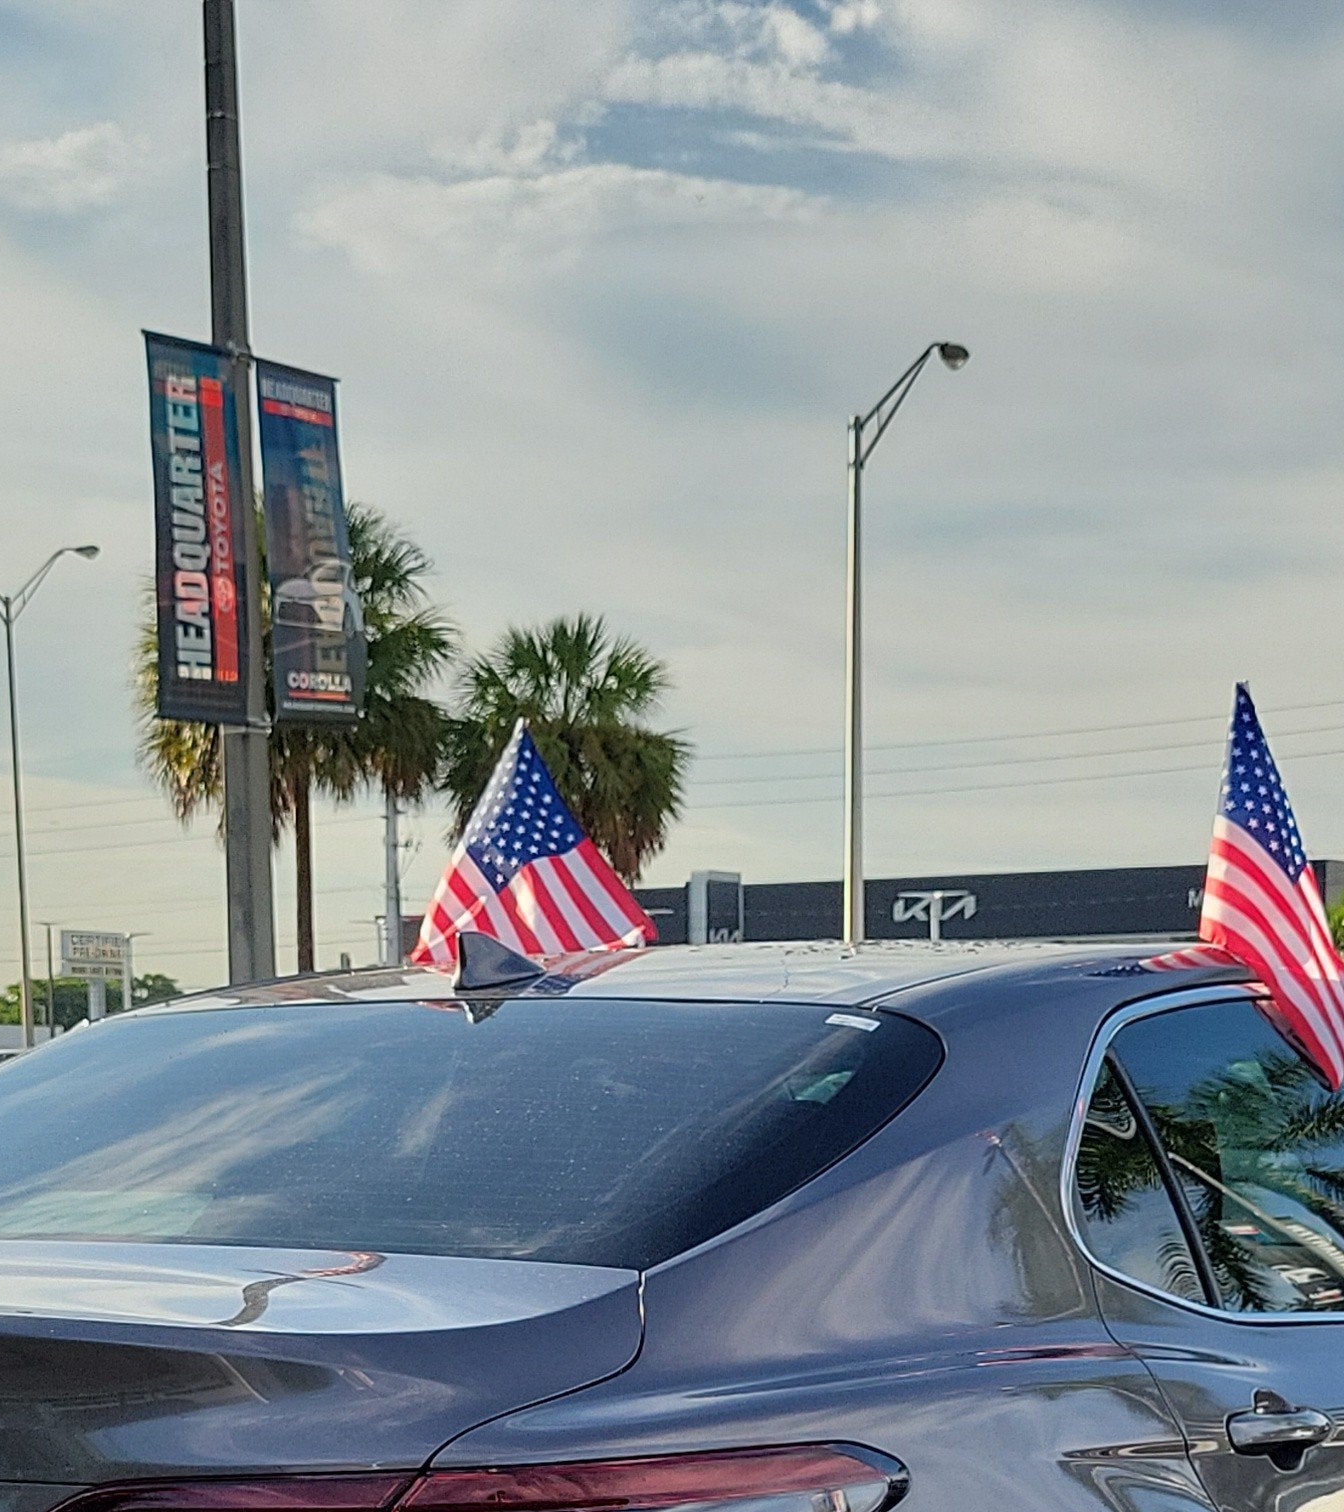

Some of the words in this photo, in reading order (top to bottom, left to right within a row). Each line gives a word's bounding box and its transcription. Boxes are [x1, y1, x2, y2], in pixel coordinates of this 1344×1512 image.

[165, 373, 213, 681] HEADQUARTER
[208, 461, 230, 571] TOYOTA
[287, 669, 353, 692] COROLLA
